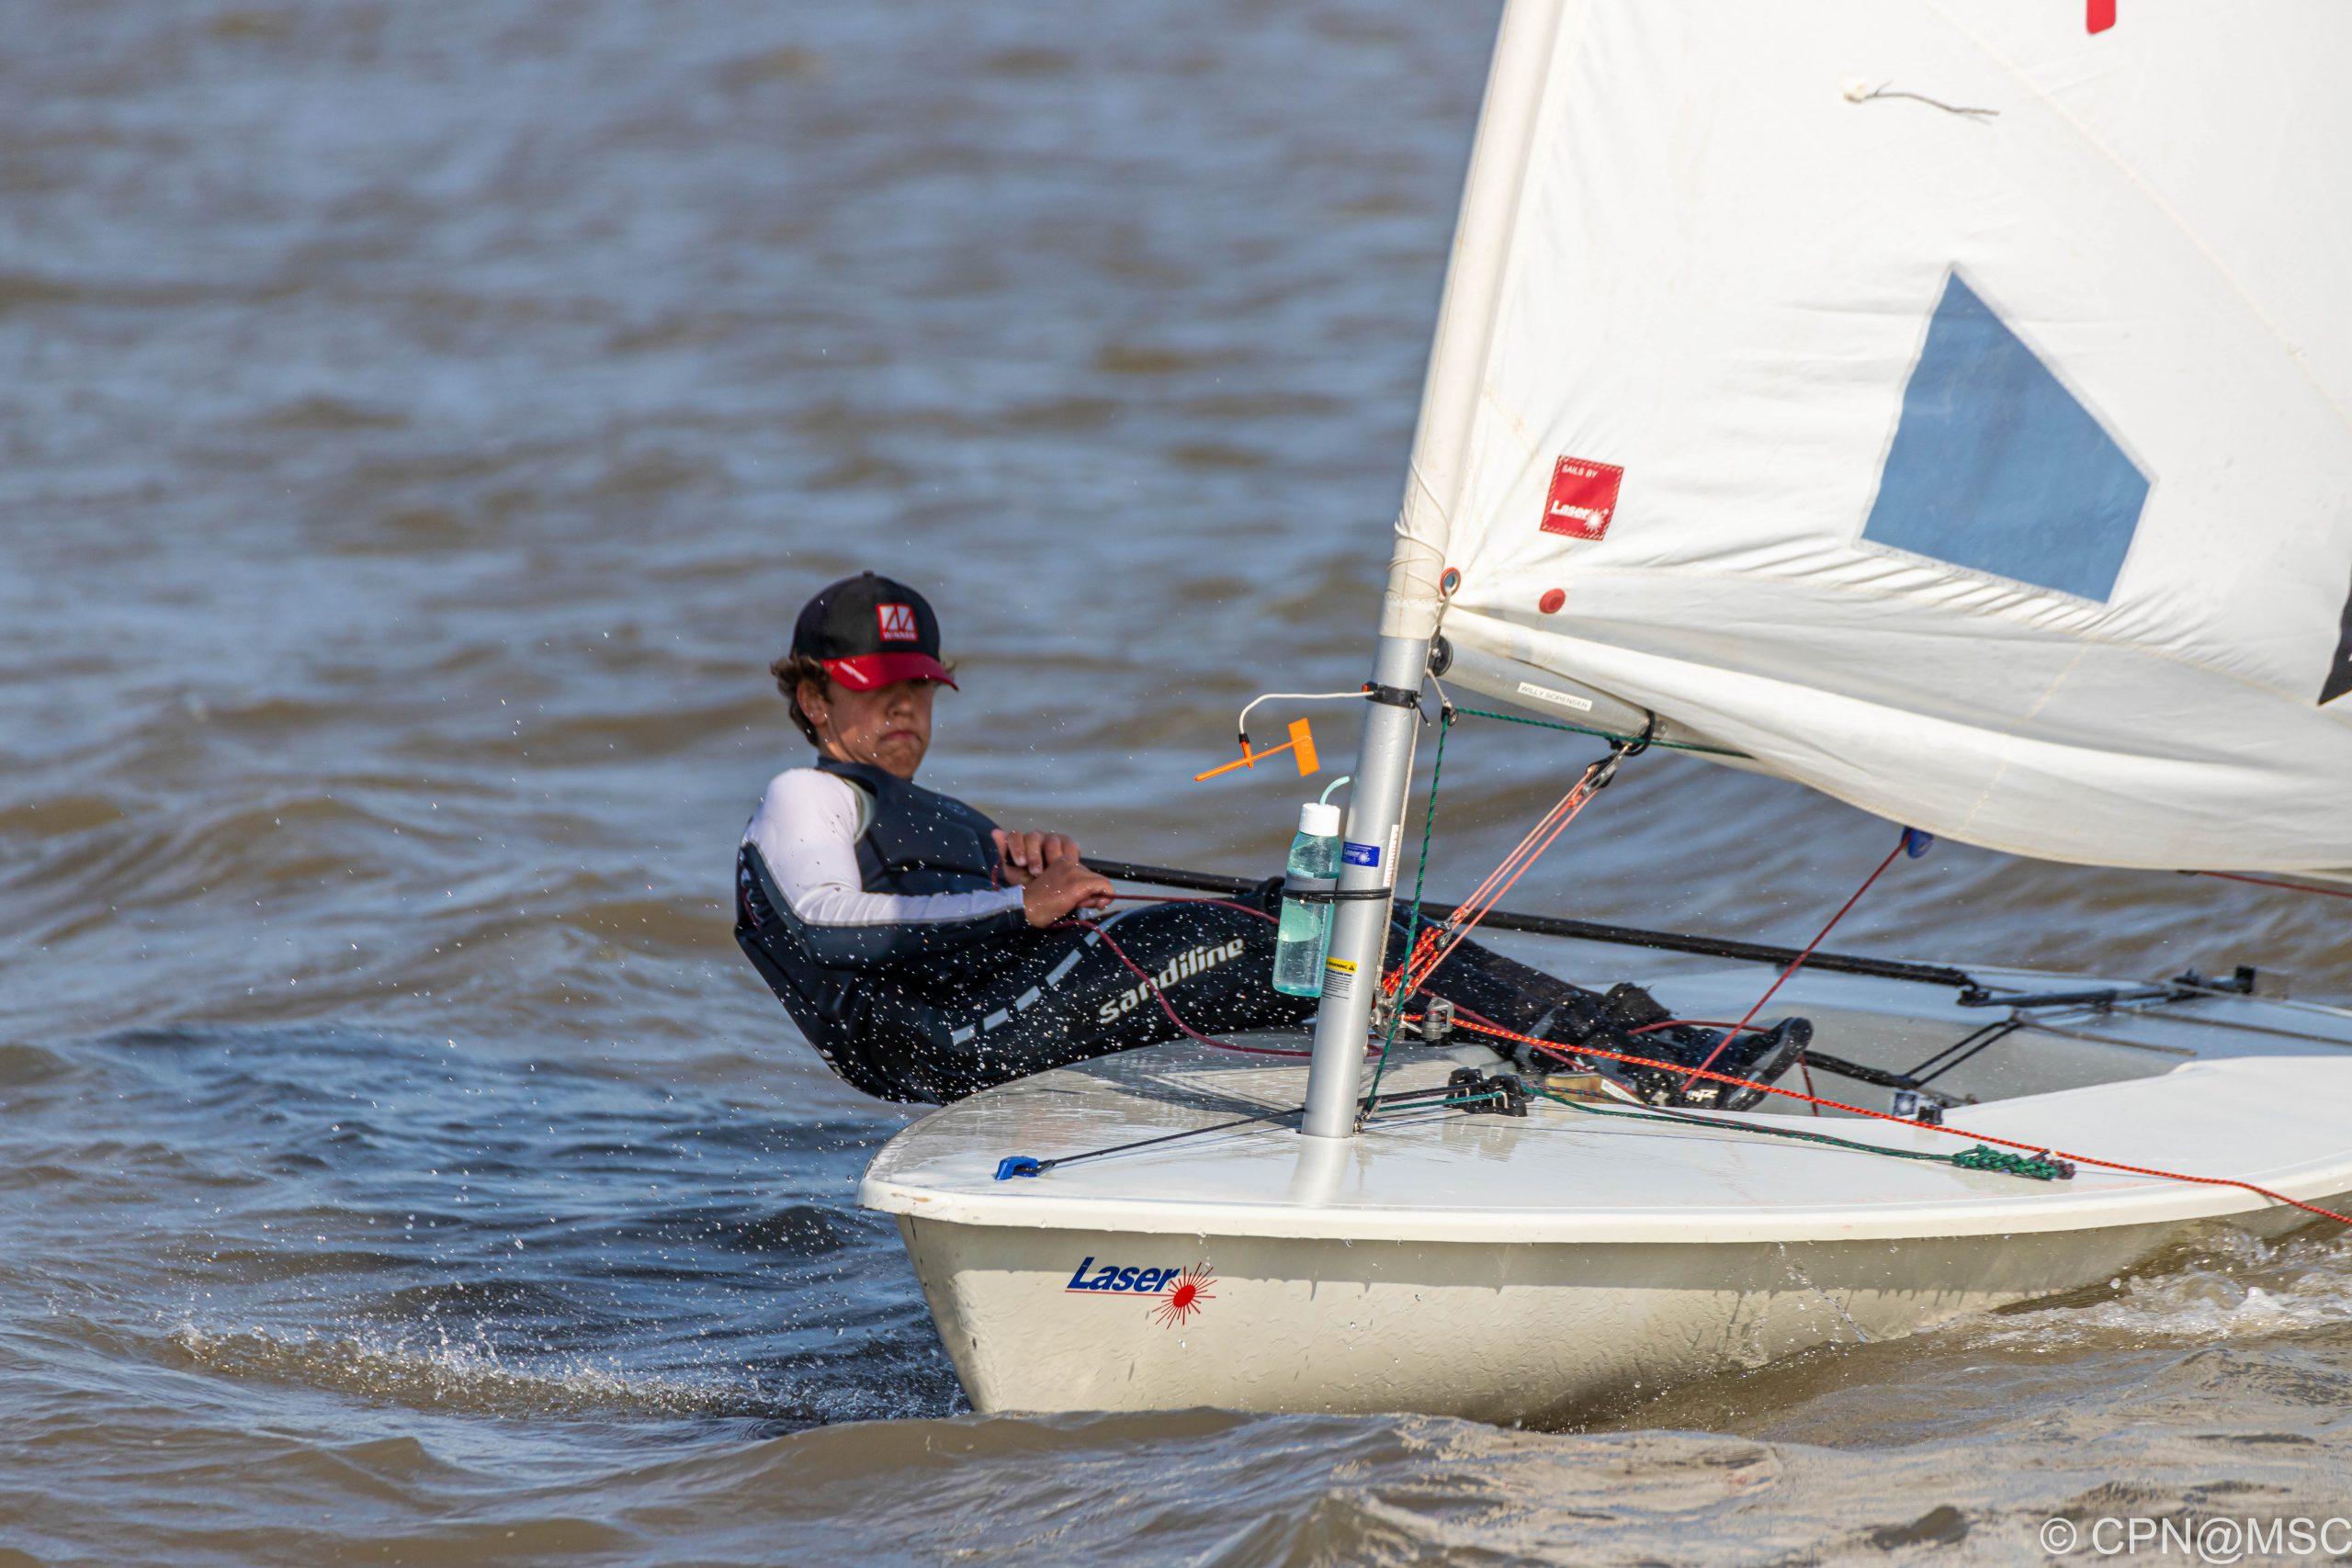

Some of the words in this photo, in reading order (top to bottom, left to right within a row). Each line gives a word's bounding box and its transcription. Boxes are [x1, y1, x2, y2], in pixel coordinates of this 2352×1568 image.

[1562, 464, 1585, 477] SAILS
[1585, 468, 1599, 479] BY
[1551, 500, 1590, 520] Laser
[1098, 938, 1245, 1024] sandiline
[1067, 1257, 1181, 1292] Laser
